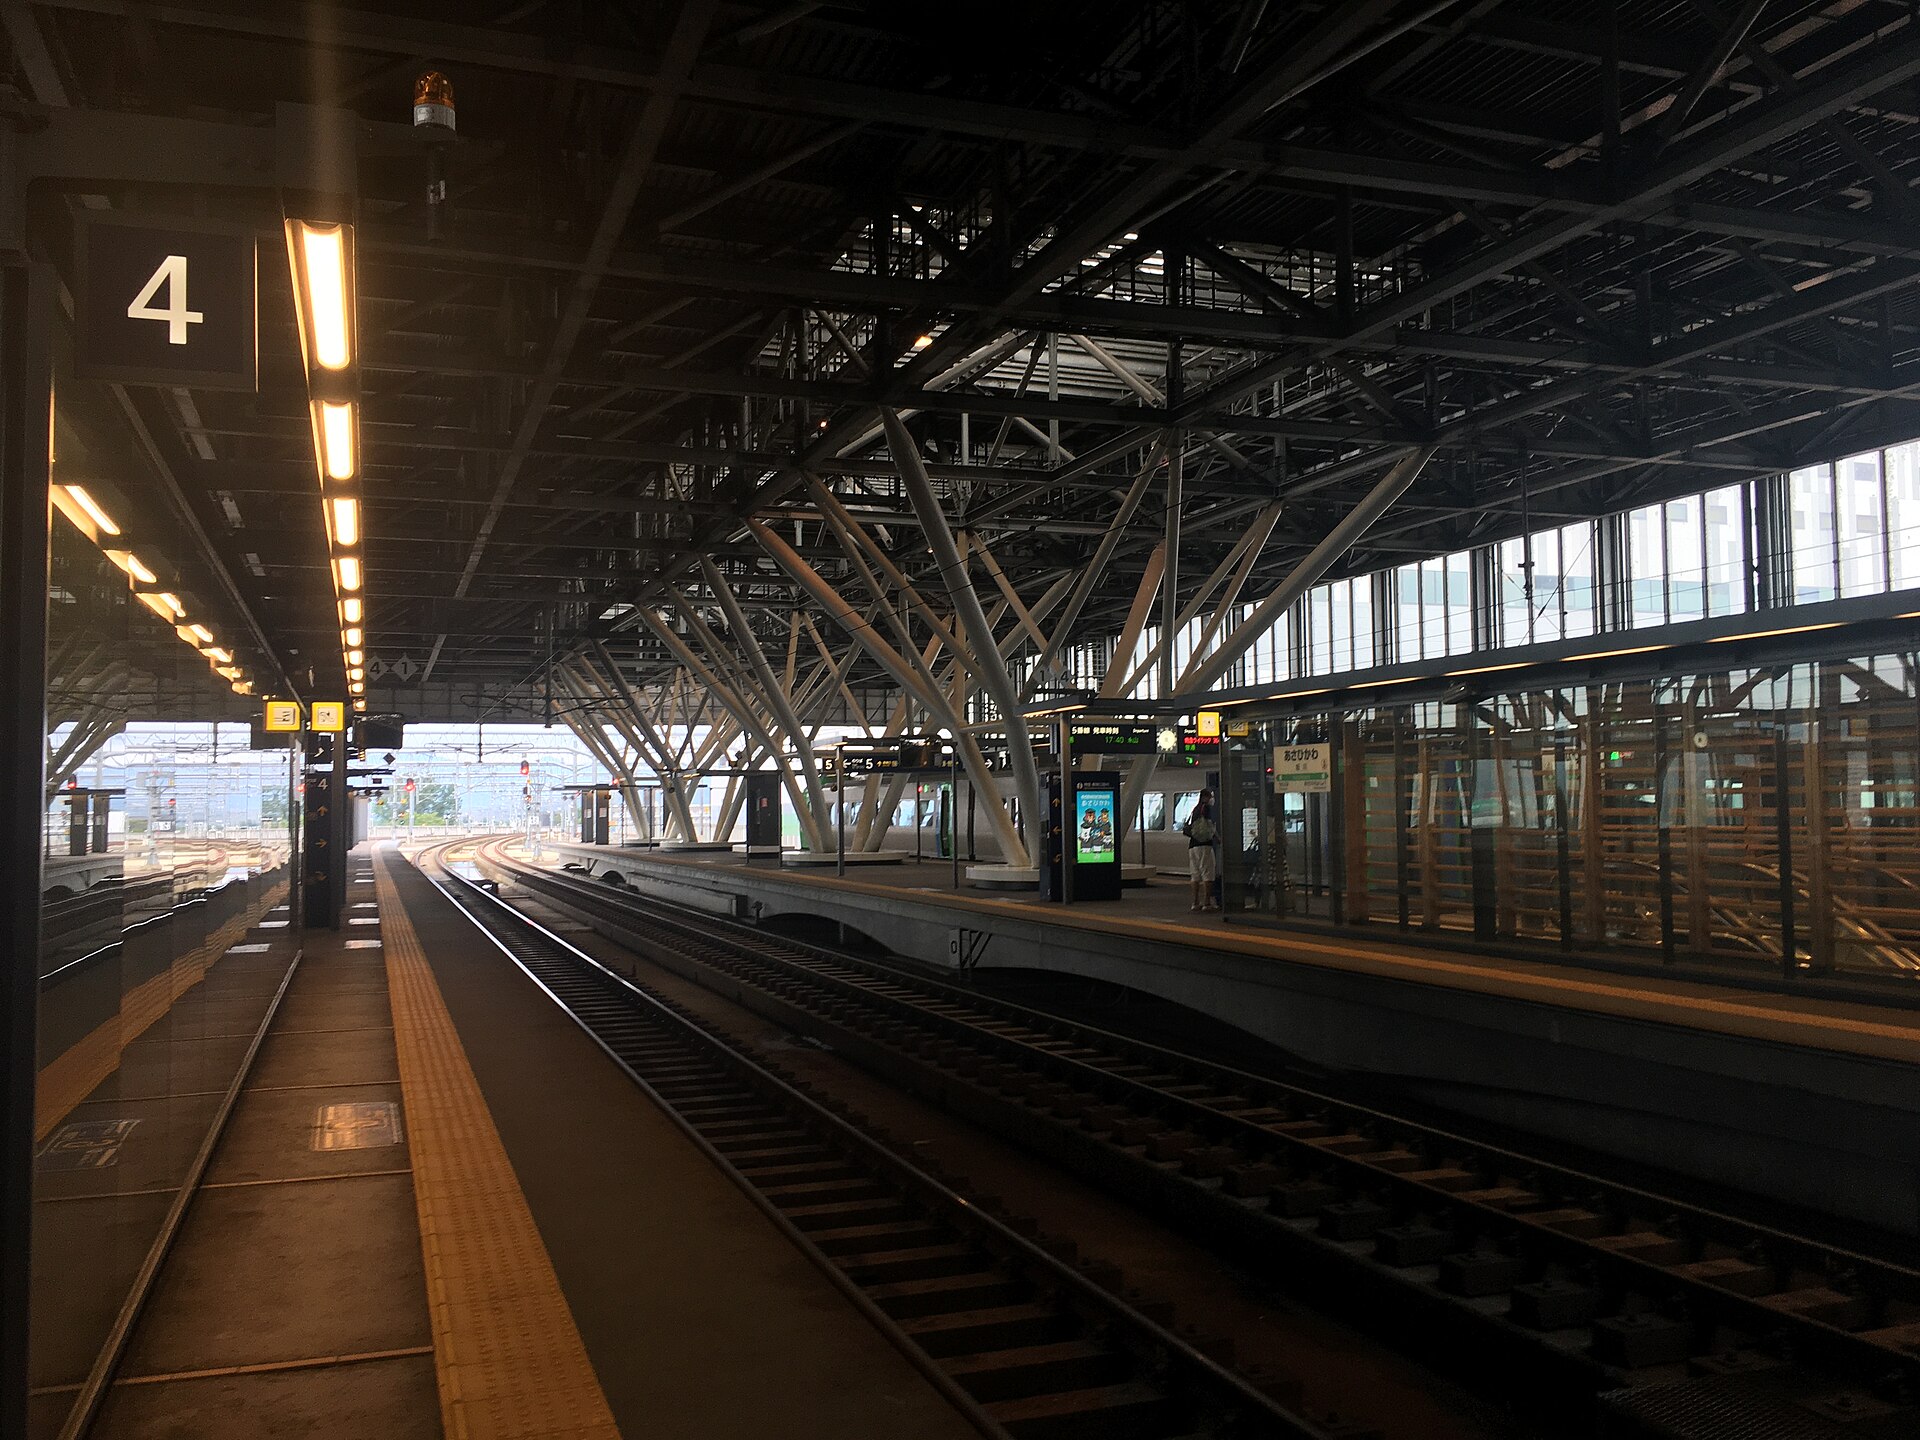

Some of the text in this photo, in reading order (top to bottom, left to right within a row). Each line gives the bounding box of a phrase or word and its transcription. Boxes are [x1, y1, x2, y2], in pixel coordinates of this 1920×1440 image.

[127, 255, 203, 345] 4
[370, 661, 380, 674] 4
[401, 661, 408, 675] 1
[1284, 747, 1319, 762] あさひかわ
[825, 759, 833, 770] 5
[865, 758, 874, 770] 5
[318, 778, 328, 790] 4
